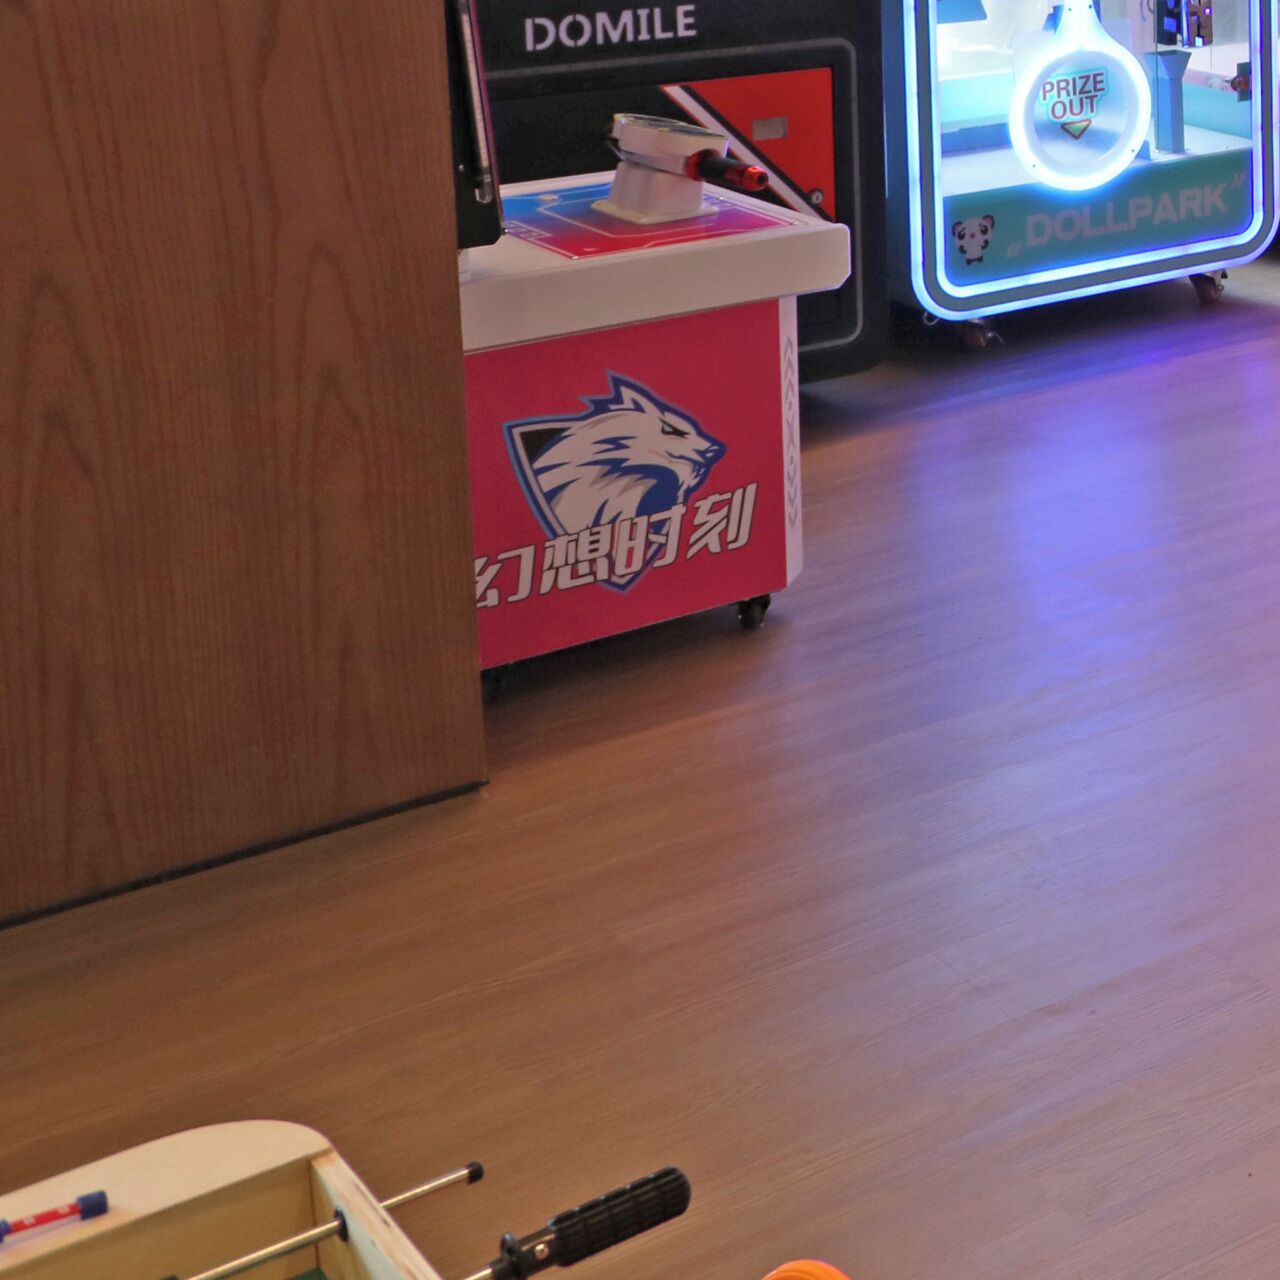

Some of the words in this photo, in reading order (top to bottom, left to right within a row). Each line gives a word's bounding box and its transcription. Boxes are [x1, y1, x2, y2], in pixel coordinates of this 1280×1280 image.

[524, 4, 698, 52] DOMILE
[1041, 71, 1106, 102] PRIZE
[1050, 94, 1098, 120] OUT
[473, 482, 759, 609] 幻想时刻
